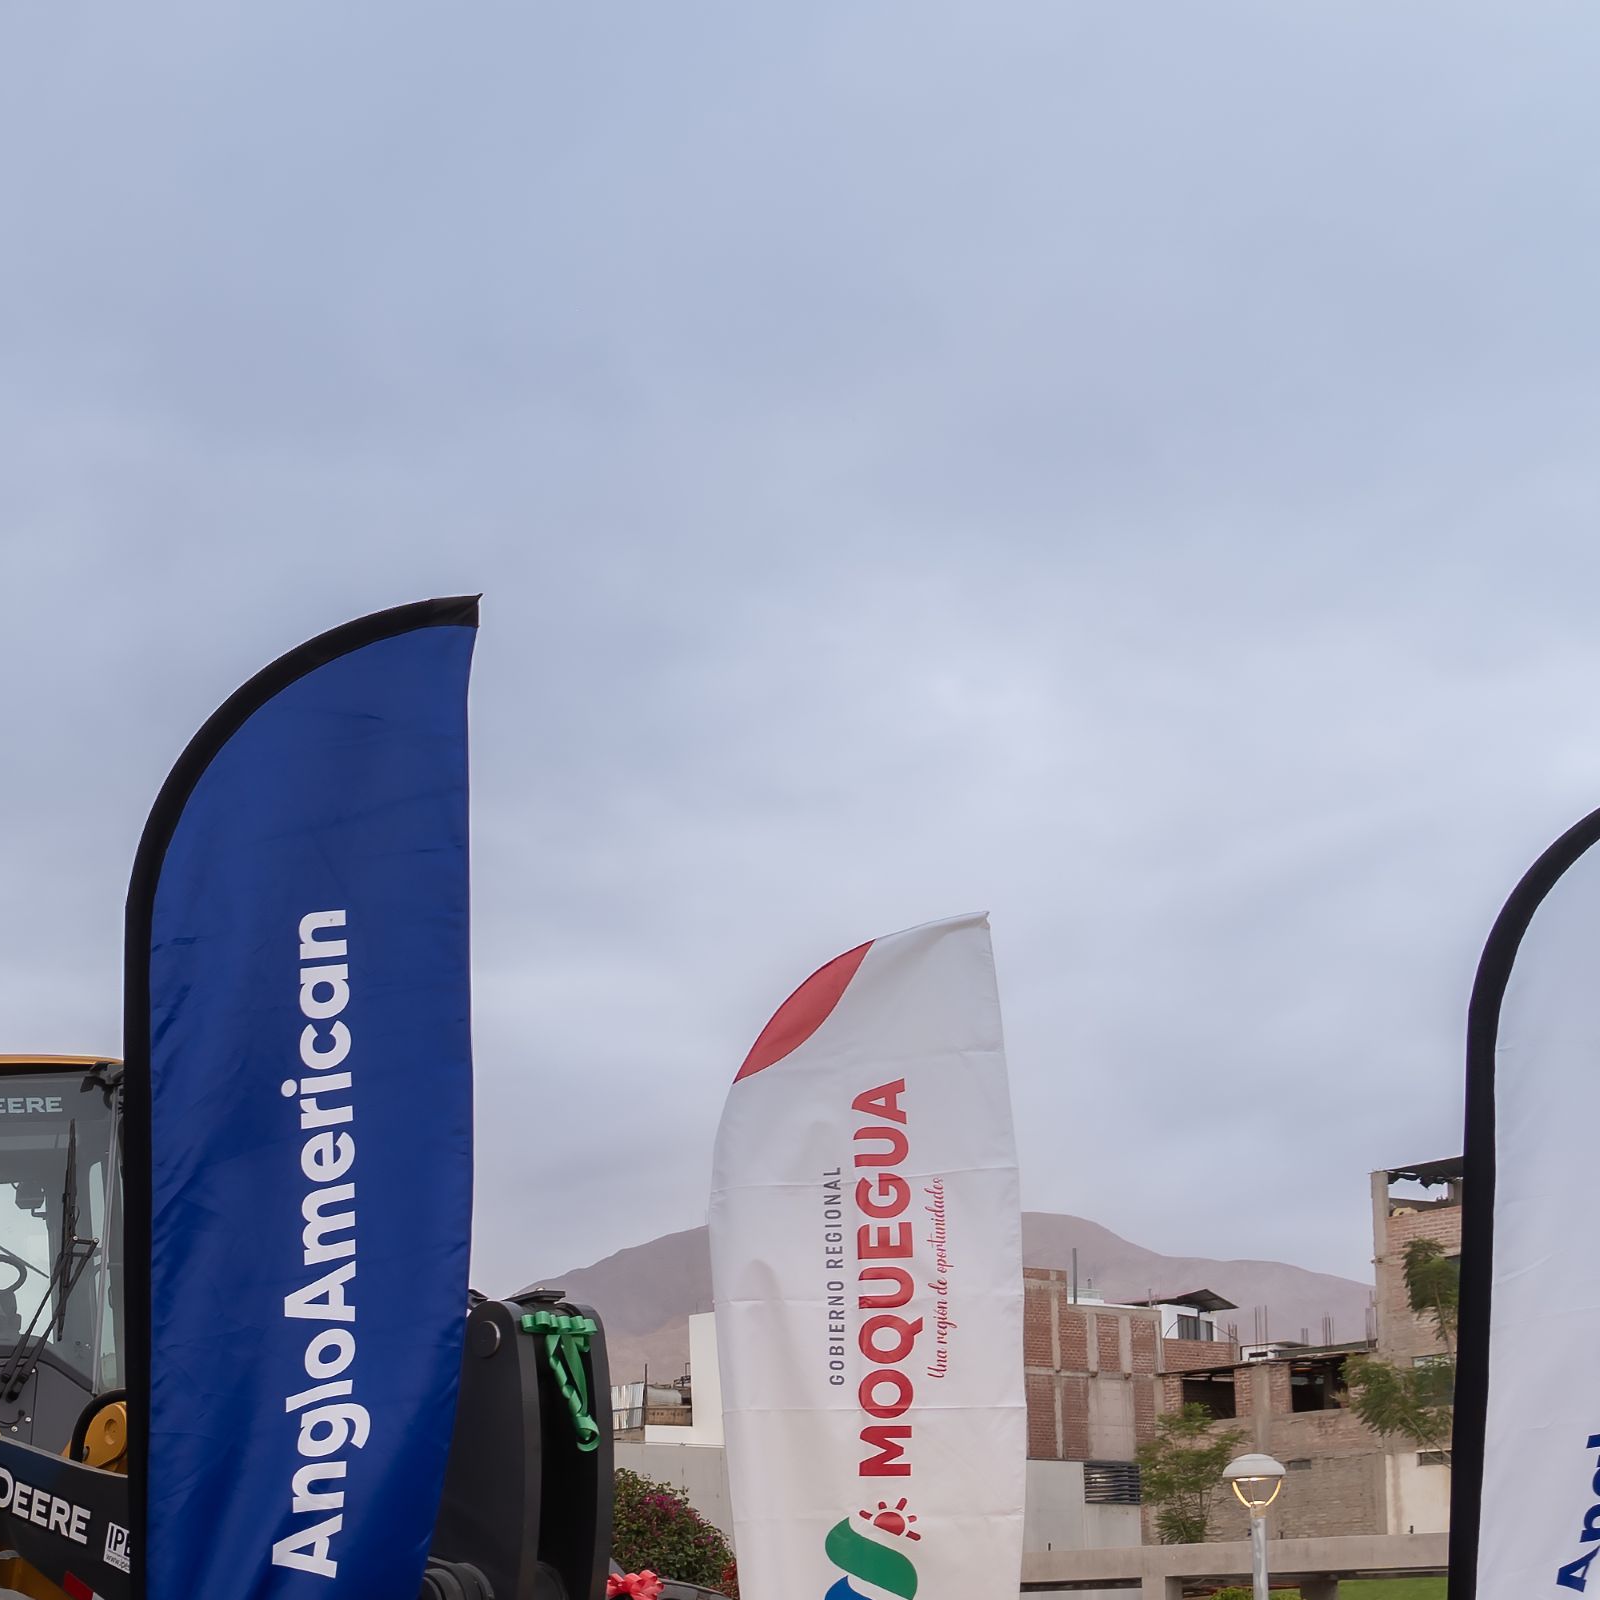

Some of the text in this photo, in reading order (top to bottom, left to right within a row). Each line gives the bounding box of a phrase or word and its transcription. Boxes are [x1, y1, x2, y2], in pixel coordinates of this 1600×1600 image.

[272, 909, 370, 1579] AngloAmerican
[823, 1167, 845, 1386] GOBIERNO REGIONAL
[851, 1078, 924, 1477] MOQUEGUA
[924, 1176, 958, 1379] Una región de oportunidades
